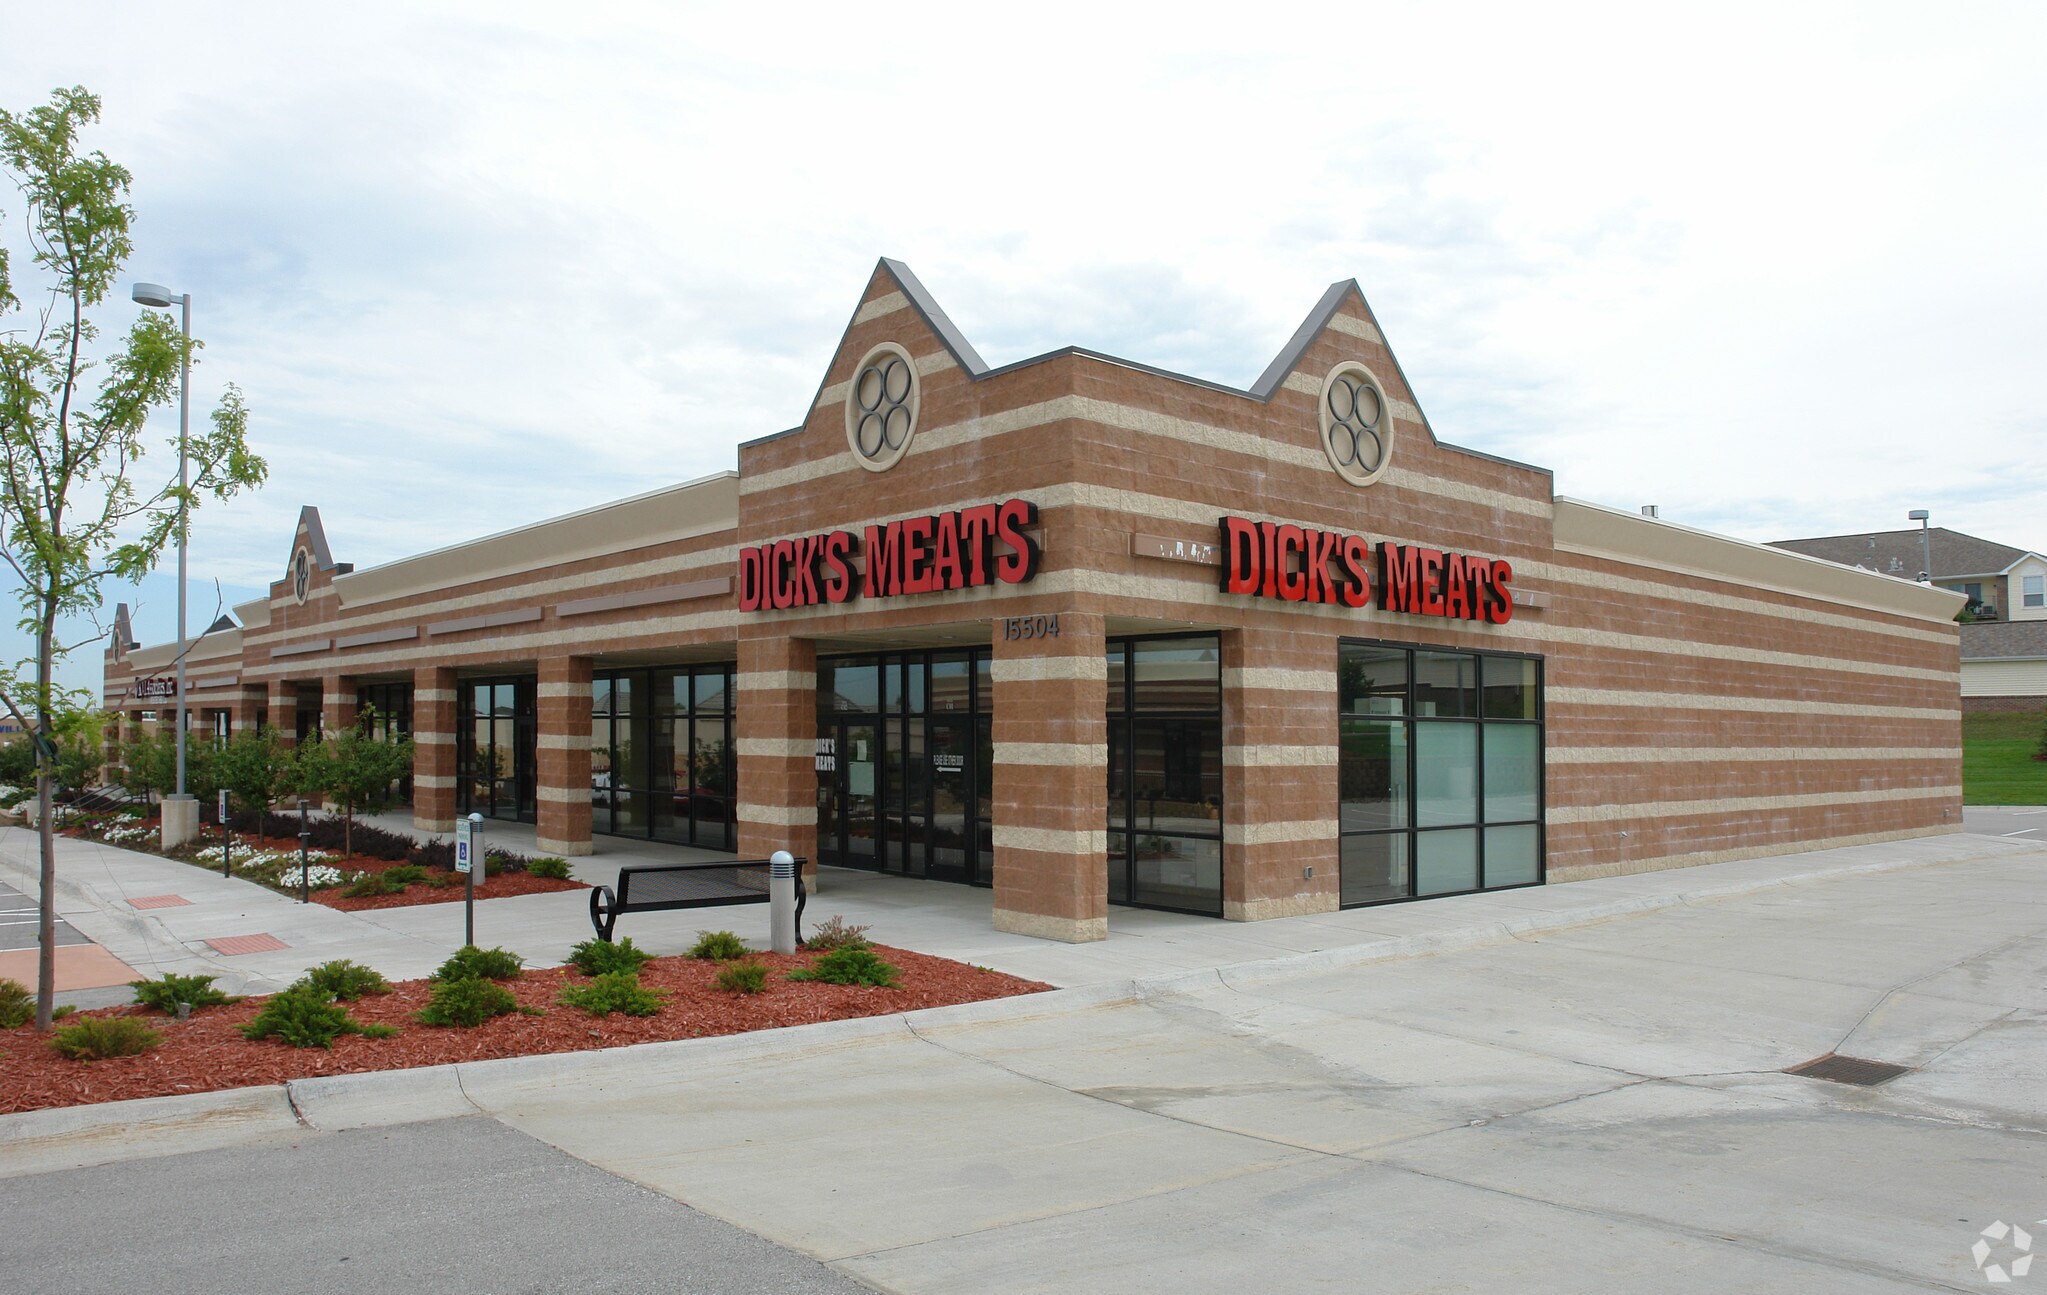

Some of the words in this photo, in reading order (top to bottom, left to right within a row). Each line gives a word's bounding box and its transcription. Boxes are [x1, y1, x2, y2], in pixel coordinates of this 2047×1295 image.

[740, 530, 854, 612] DICK'S
[864, 499, 1037, 598] MEATS
[1221, 516, 1370, 608] DICK'S
[1378, 542, 1512, 625] MEATS
[1003, 614, 1059, 640] 15504
